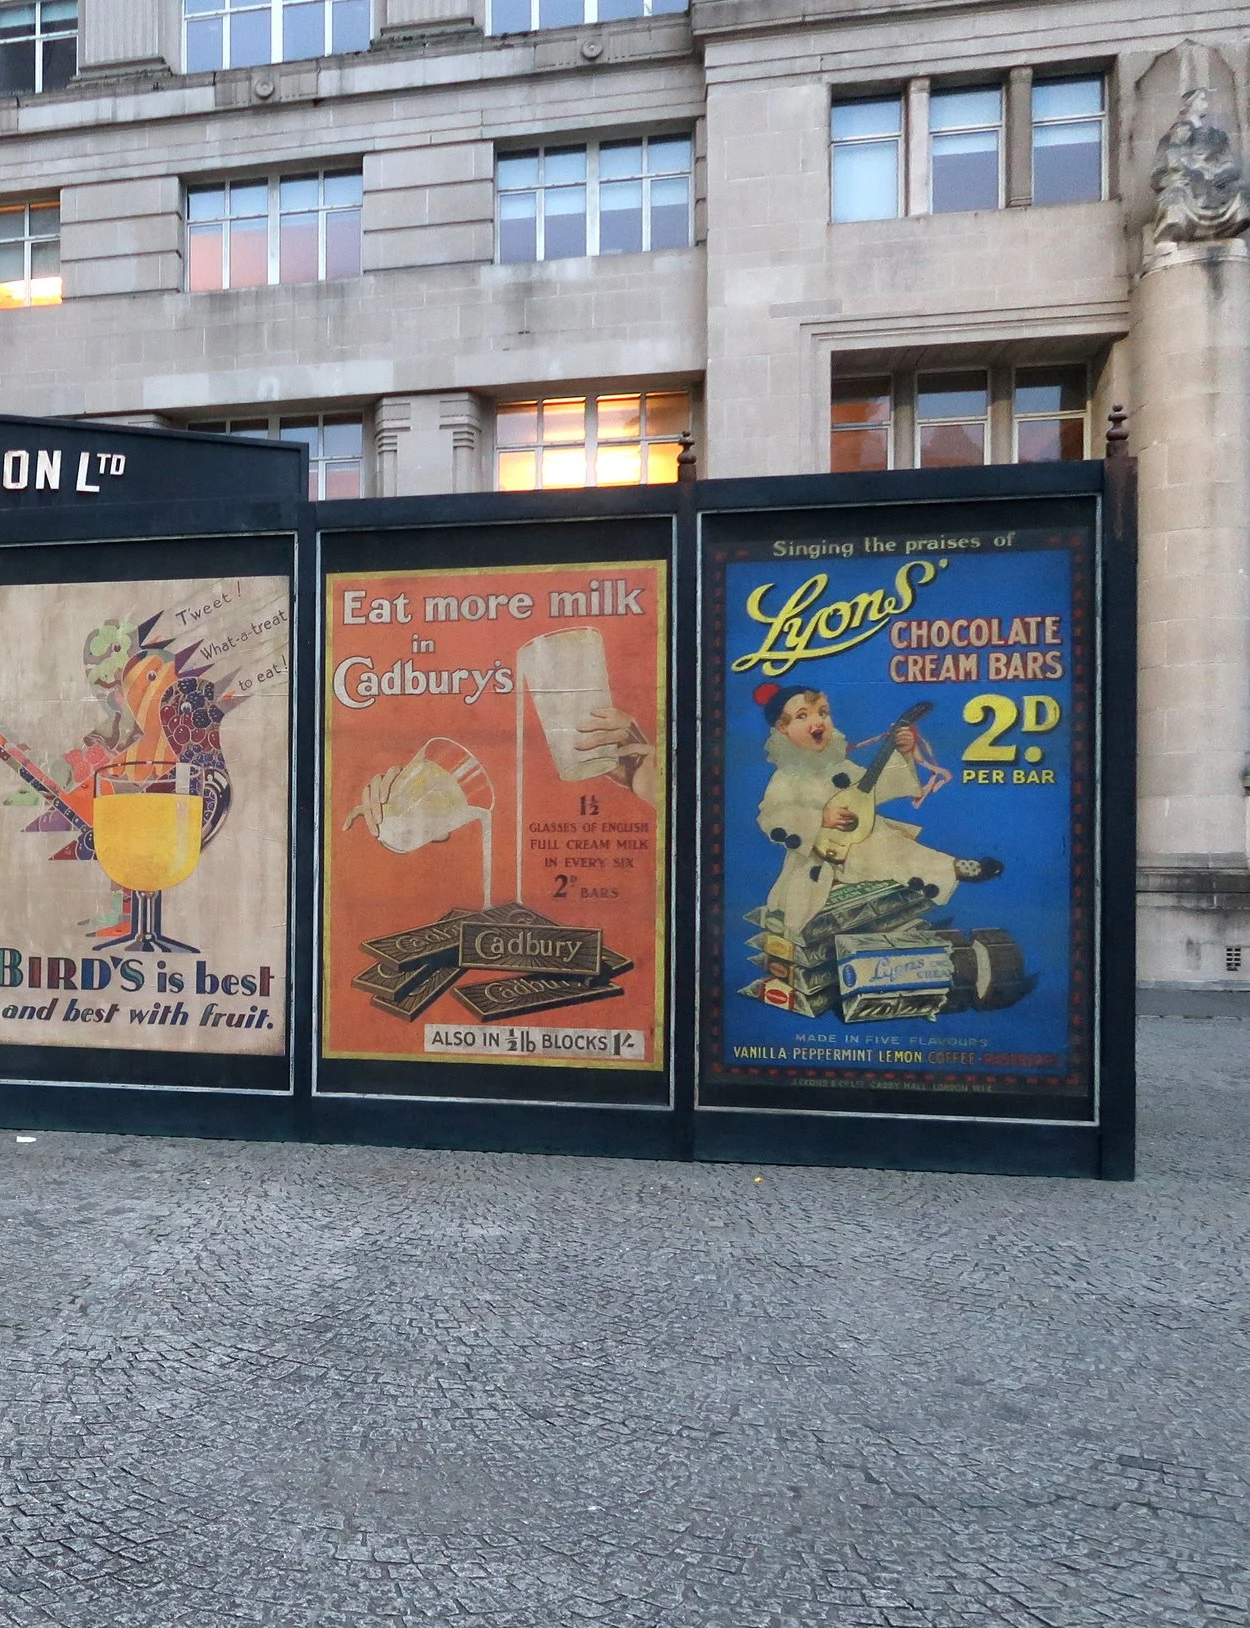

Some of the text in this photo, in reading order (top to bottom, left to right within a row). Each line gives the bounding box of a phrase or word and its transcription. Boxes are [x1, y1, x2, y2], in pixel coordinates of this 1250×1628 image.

[773, 531, 1015, 559] Singing the praises of
[342, 578, 646, 626] Eat more milk
[889, 616, 1063, 650] CHOCOLATE
[411, 633, 436, 654] in
[889, 650, 1064, 684] CREAM BARS
[238, 679, 253, 691] to
[333, 655, 515, 709] Cadbury's
[962, 770, 1055, 785] PER BAR
[529, 822, 649, 833] GLASSES OF ENGLISH
[530, 839, 649, 850] FULL CREAM MILK
[545, 857, 635, 868] IN EVERY SIX
[580, 887, 620, 899] BARS
[474, 930, 583, 963] Cadbury
[157, 960, 184, 994] is
[195, 960, 275, 997] best
[62, 998, 120, 1023] best
[128, 1001, 189, 1026] with
[199, 1003, 274, 1030] fruit.
[431, 1031, 476, 1046] ALSO
[483, 1032, 499, 1047] IN
[542, 1033, 608, 1051] BLOCKS
[795, 1034, 989, 1047] MADE IN FIVE FLAVOURS
[878, 1050, 922, 1064] LEMON
[928, 1051, 976, 1065] COFFEE
